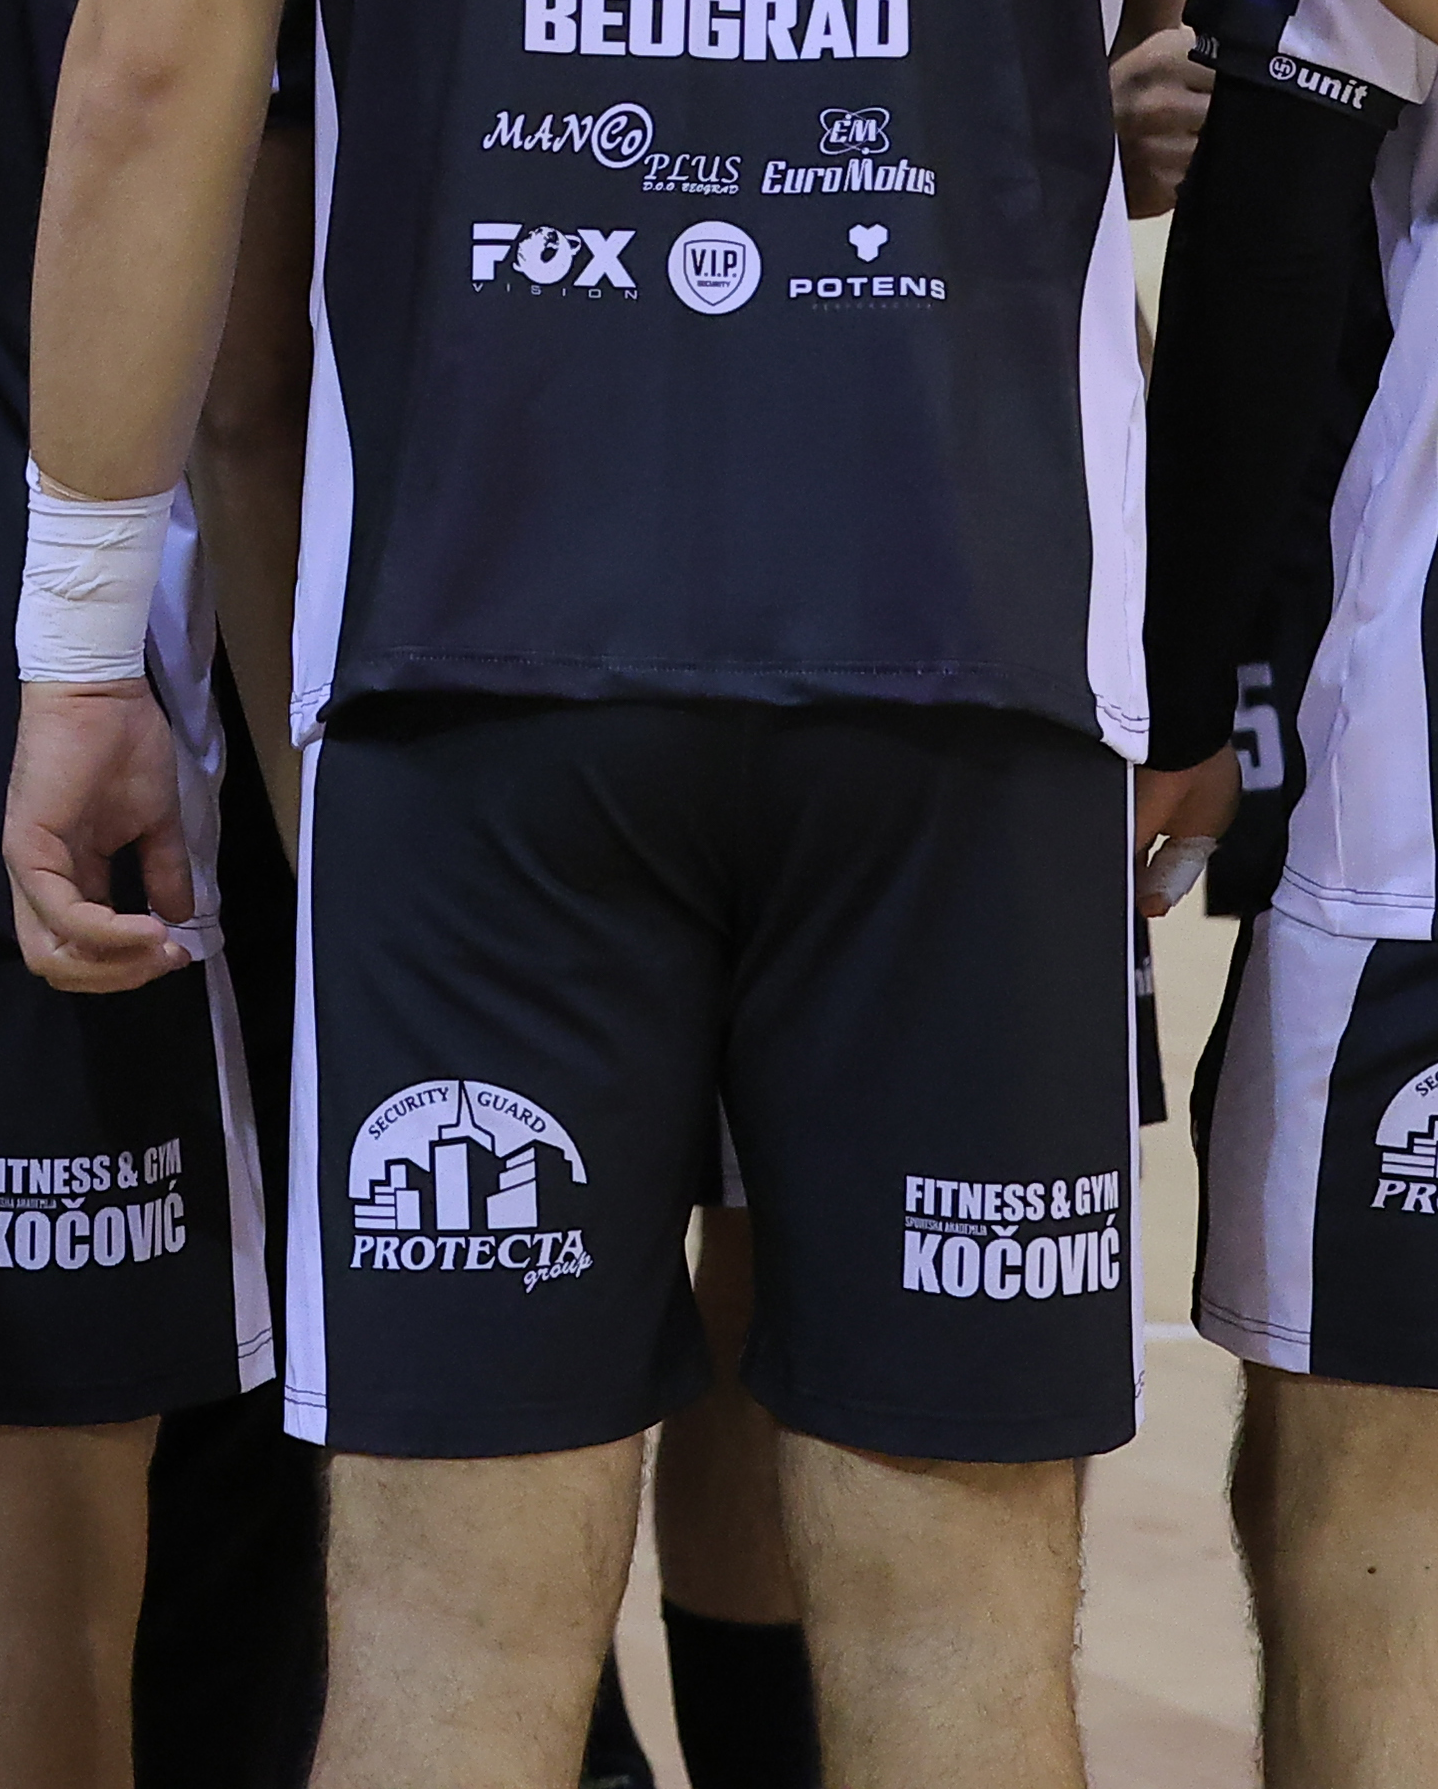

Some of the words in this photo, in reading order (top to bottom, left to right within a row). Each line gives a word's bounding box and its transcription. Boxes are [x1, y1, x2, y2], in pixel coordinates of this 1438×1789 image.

[1297, 68, 1368, 109] unit
[644, 154, 742, 183] PLUS
[472, 223, 636, 288] FOX
[691, 248, 737, 278] V.I.P.
[472, 283, 638, 300] VISION
[789, 277, 946, 300] POTENS
[368, 1086, 449, 1140] SECURITY
[477, 1091, 546, 1134] GUARD
[117, 1151, 138, 1189] &
[144, 1138, 182, 1184] GYM
[906, 1175, 1046, 1222] FITNESS
[1050, 1180, 1071, 1220] &
[1075, 1171, 1119, 1216] GYM
[350, 1229, 583, 1271] PROTECTA
[903, 1213, 1120, 1300] KOČOVIĆ
[524, 1251, 593, 1293] group
